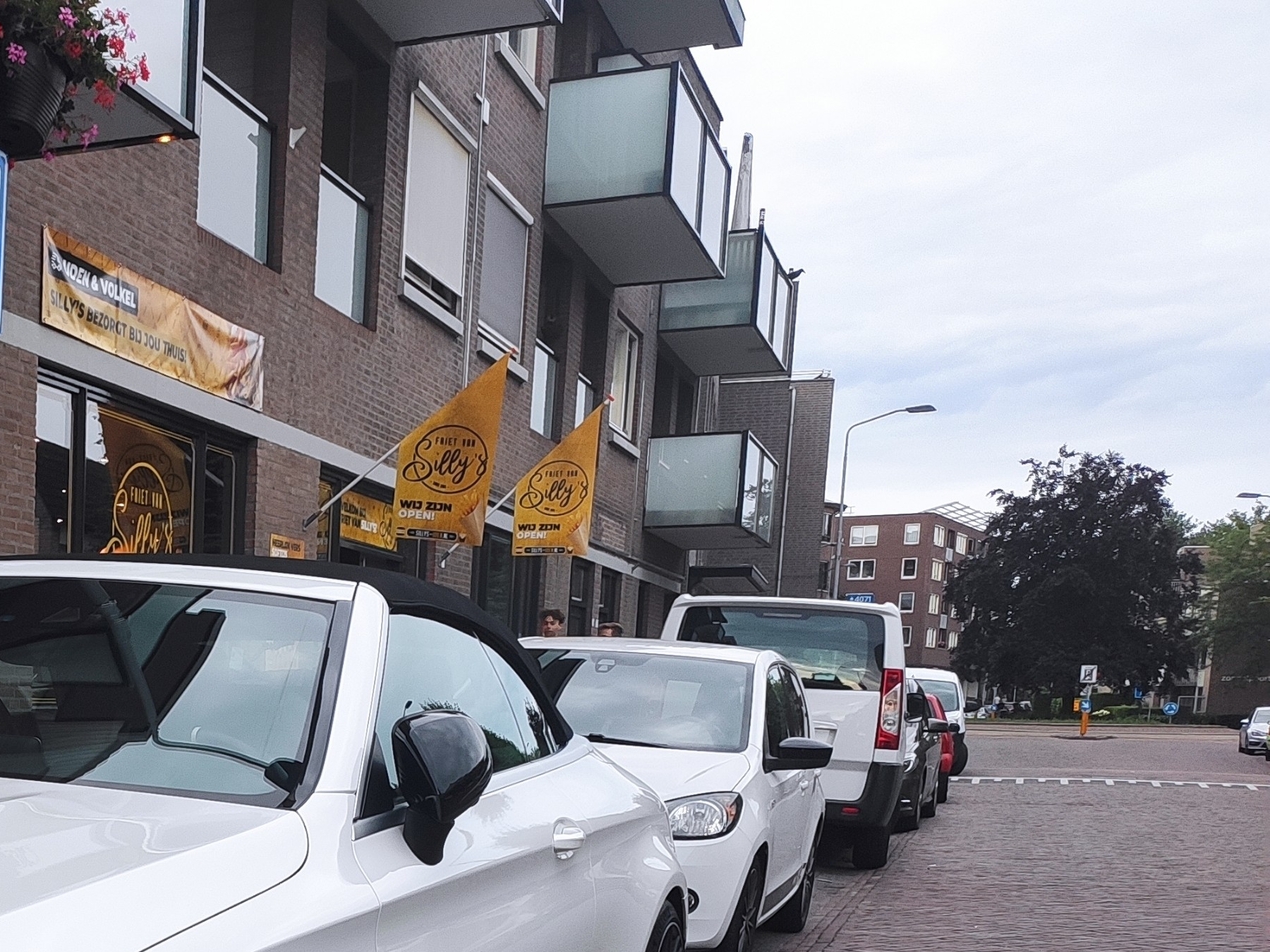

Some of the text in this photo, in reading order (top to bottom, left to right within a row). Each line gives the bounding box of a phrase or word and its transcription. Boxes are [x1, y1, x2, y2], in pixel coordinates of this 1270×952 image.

[91, 274, 99, 292] &
[99, 277, 137, 309] VOLKEL
[50, 289, 187, 364] SILLY'S BEZORGT BIJ JOU THUIS!
[402, 438, 488, 485] Silly's
[519, 472, 589, 509] Silly's
[399, 499, 452, 513] WIJ ZIJN
[398, 509, 435, 521] OPEN!
[517, 523, 561, 532] WIJ ZIJN
[516, 531, 548, 540] OPEN!
[854, 595, 872, 603] 4071
